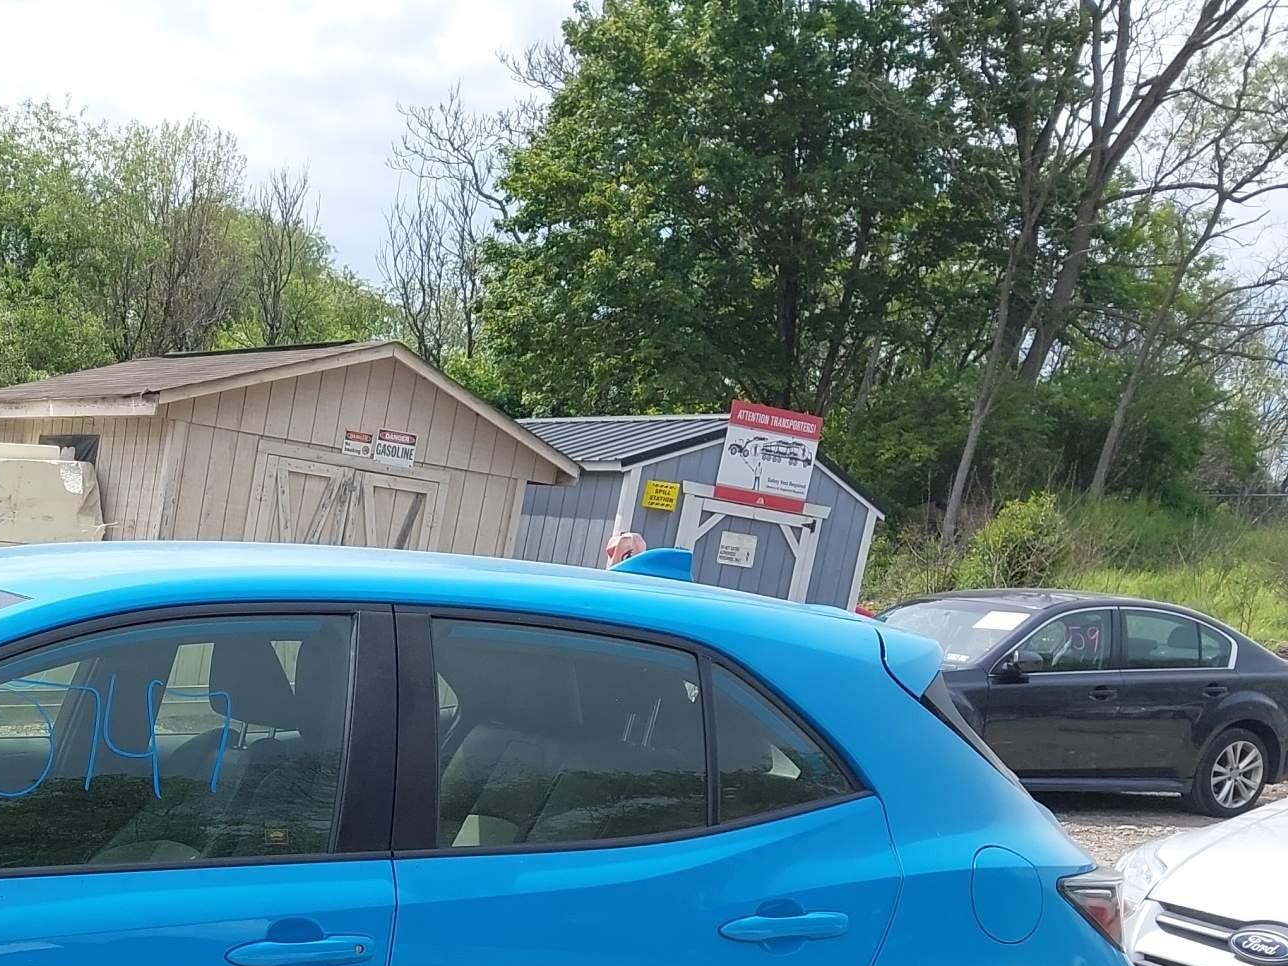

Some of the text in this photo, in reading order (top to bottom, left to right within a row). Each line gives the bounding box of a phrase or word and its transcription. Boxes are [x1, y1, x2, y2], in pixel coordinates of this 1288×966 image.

[737, 409, 817, 434] ATTENTION TRANSPORTERS!
[385, 432, 411, 444] DANGER
[375, 442, 415, 461] GASOLINE
[649, 494, 674, 504] STATION
[654, 488, 672, 496] SPILL
[1241, 935, 1281, 956] Ford
